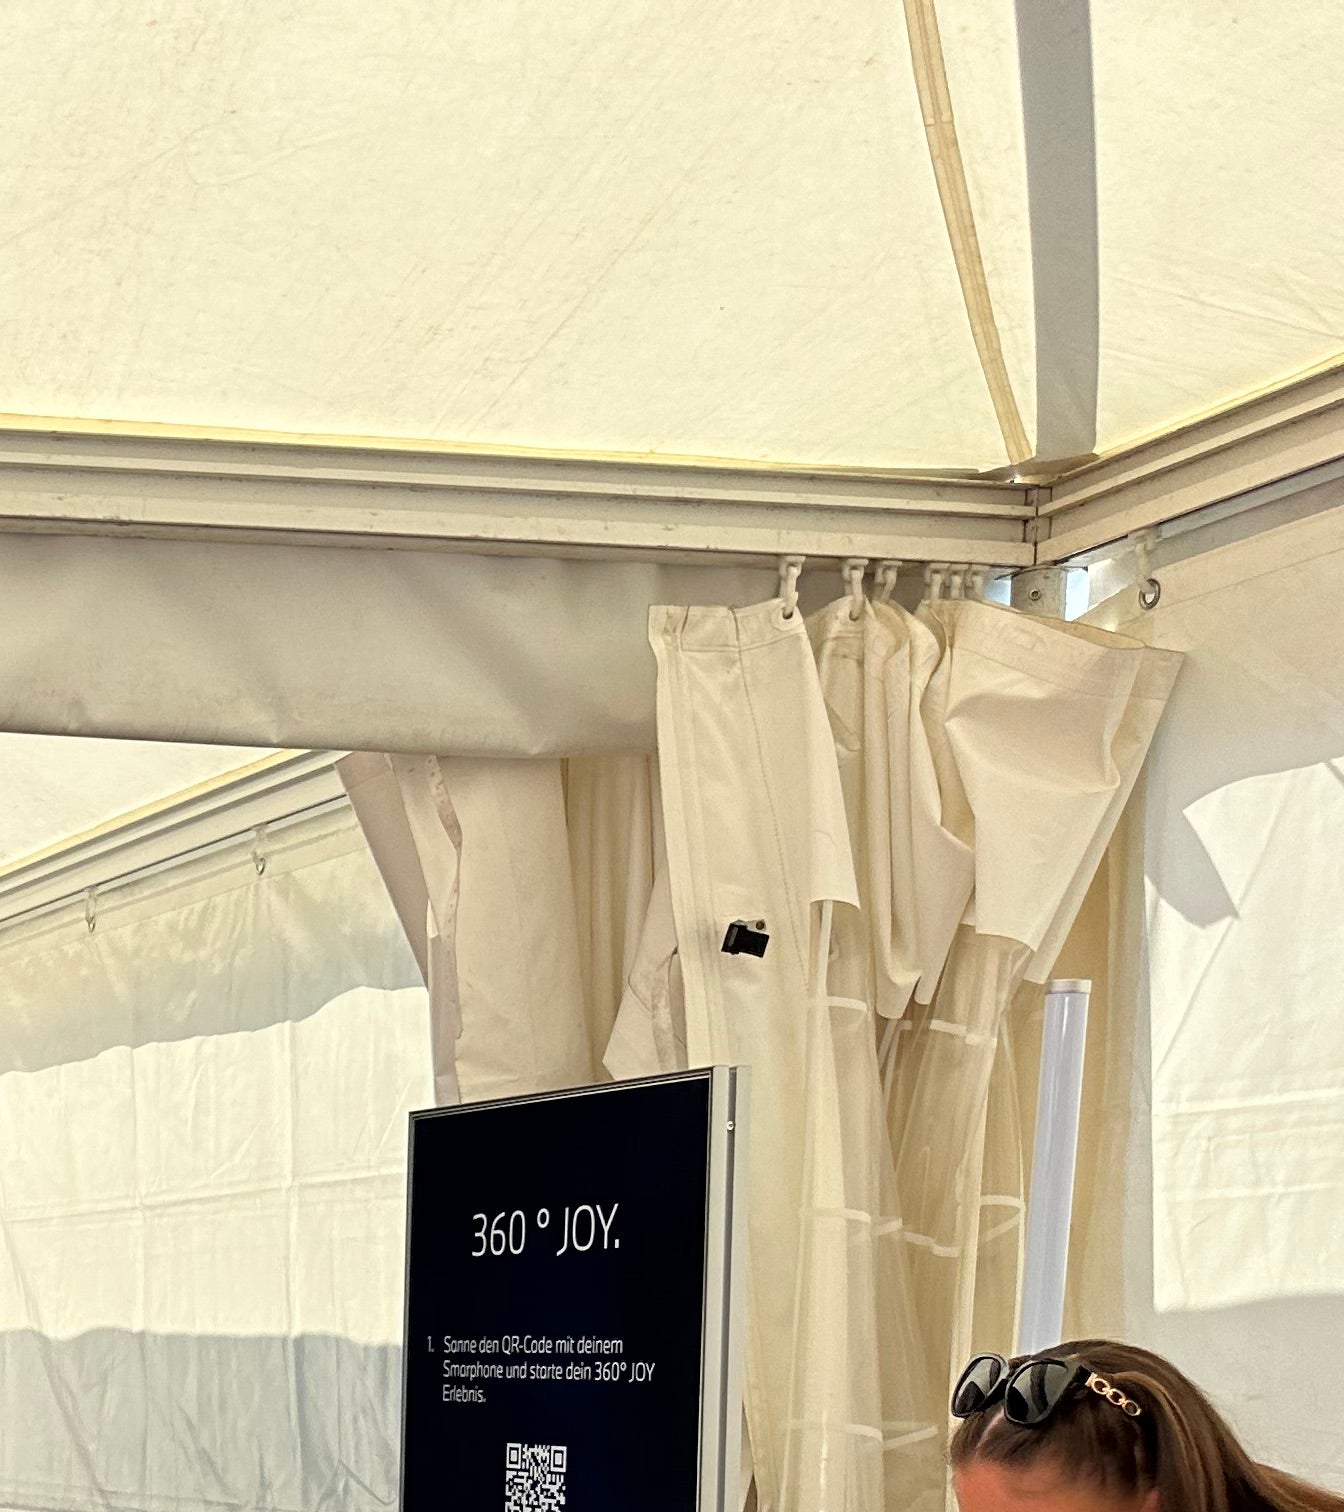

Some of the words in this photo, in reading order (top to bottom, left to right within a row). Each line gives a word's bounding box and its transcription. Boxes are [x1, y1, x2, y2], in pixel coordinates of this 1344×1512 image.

[556, 1203, 620, 1257] JOY.
[478, 1335, 500, 1354] den
[501, 1335, 553, 1356] QR-Code
[555, 1335, 575, 1354] mit
[576, 1335, 624, 1354] deinem
[442, 1359, 504, 1381] Smarphone
[505, 1360, 528, 1379] und
[529, 1363, 563, 1380] starte
[565, 1361, 592, 1381] dein
[594, 1361, 628, 1382] 360°
[628, 1361, 656, 1384] JOY
[442, 1383, 487, 1403] Erlebnis.
